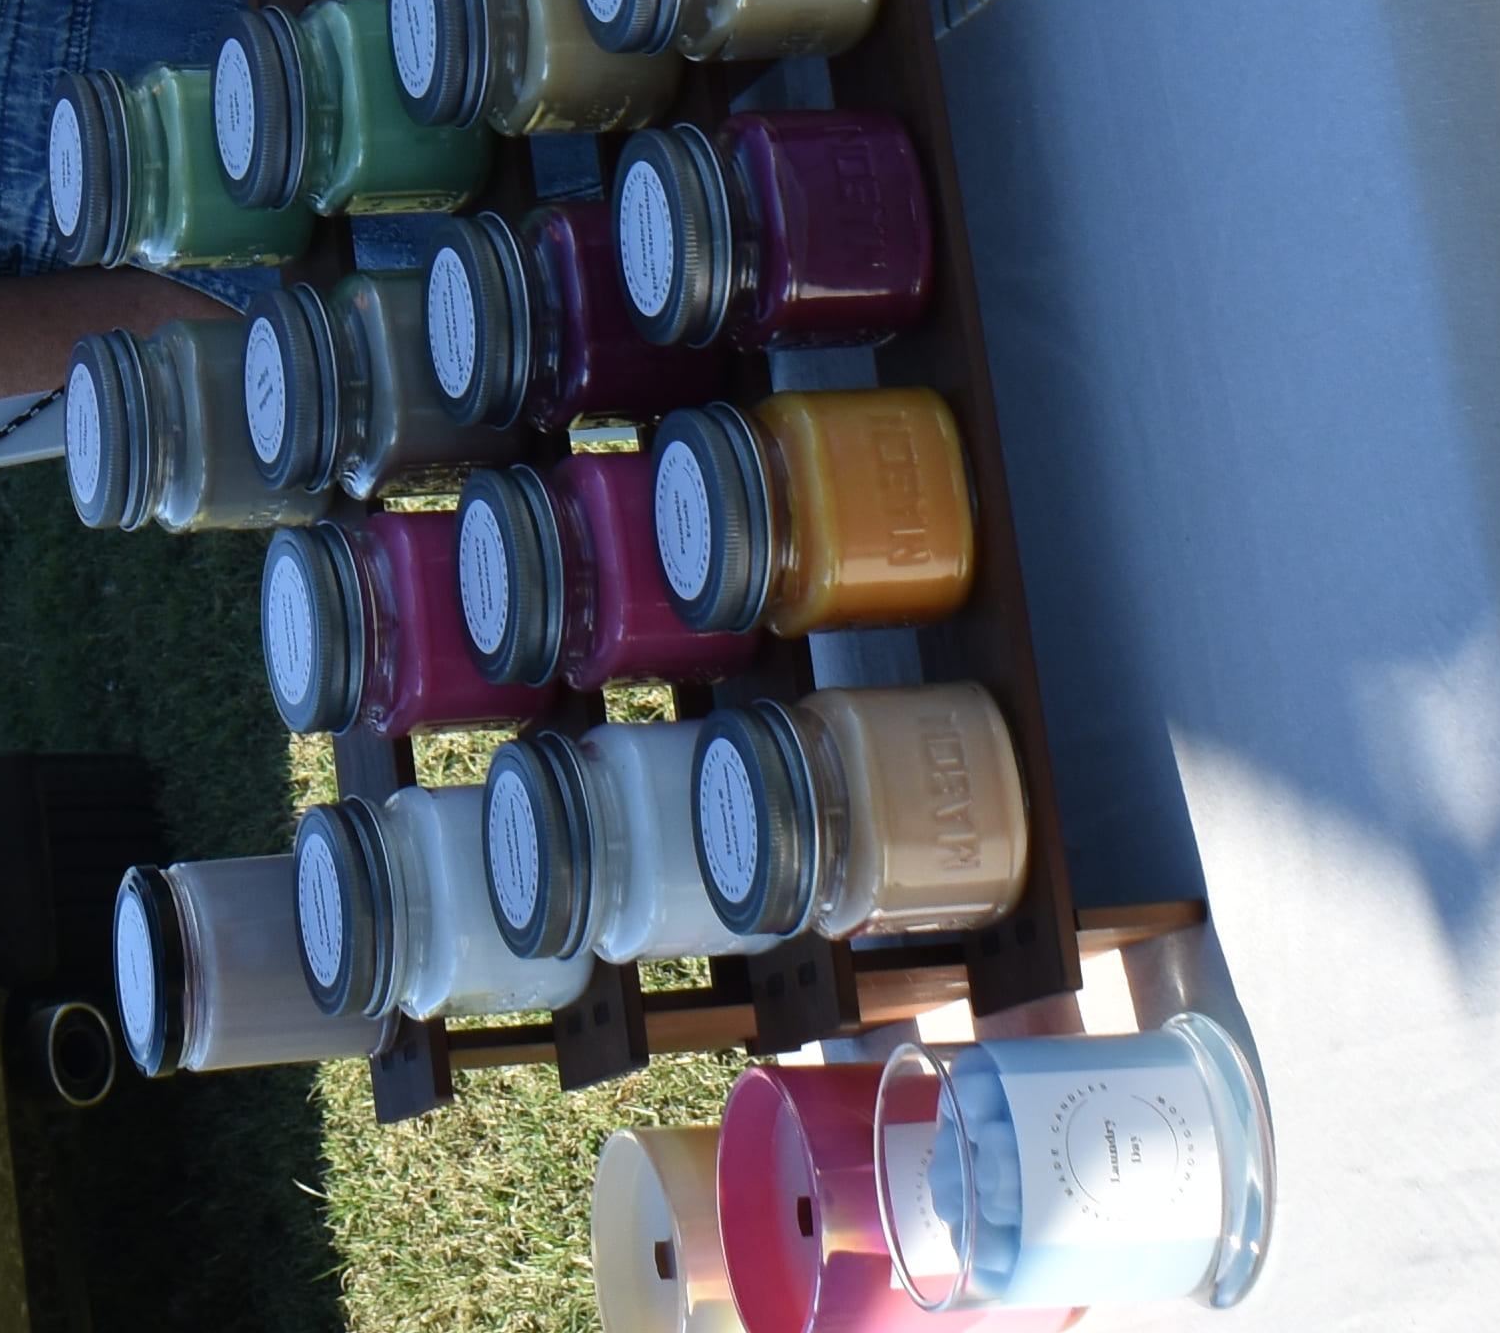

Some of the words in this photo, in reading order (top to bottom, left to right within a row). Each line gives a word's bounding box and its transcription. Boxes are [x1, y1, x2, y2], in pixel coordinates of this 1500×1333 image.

[916, 710, 982, 869] MASON
[1103, 1117, 1120, 1183] Laundry
[1129, 1133, 1142, 1163] Day
